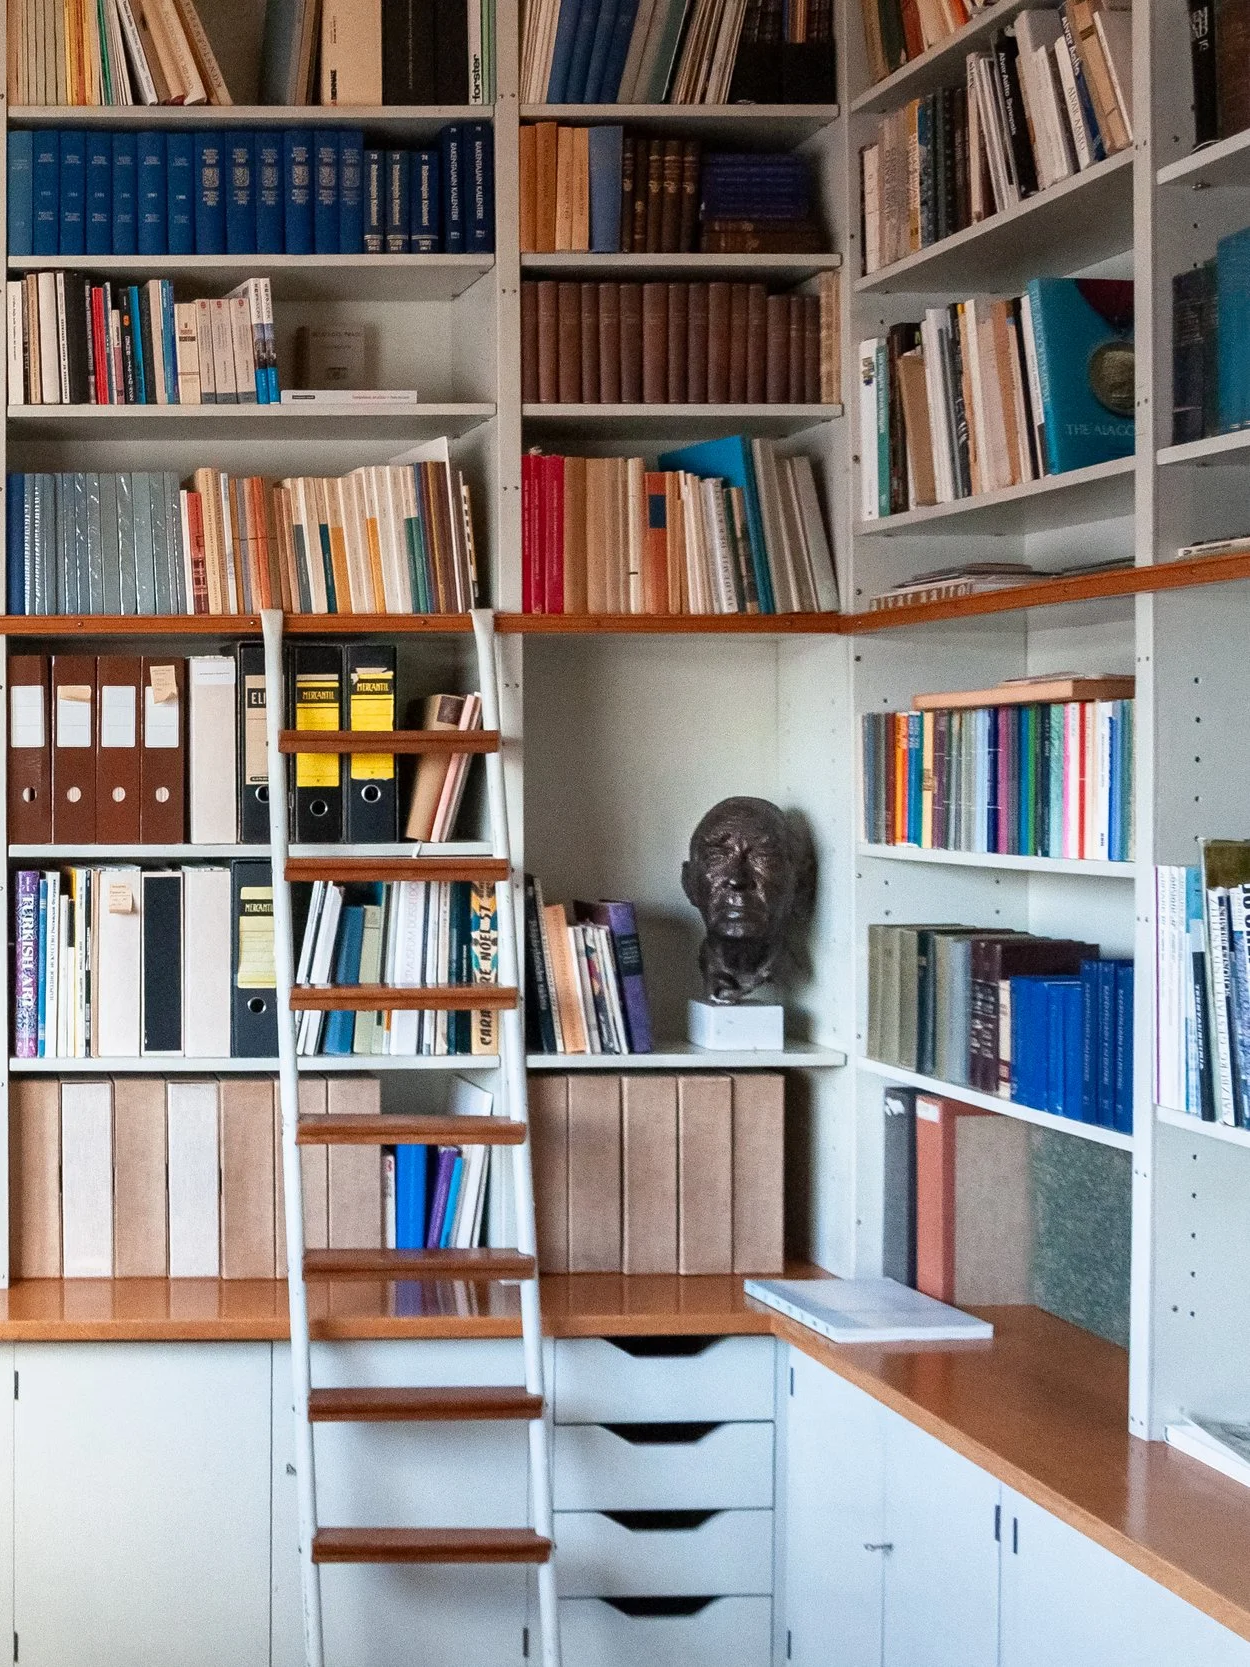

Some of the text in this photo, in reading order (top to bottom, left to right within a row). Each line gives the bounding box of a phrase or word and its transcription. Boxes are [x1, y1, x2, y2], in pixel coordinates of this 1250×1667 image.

[1060, 16, 1081, 76] Alvar Aalto
[471, 53, 481, 103] forster
[997, 52, 1017, 136] Alvar Aalto Synopsis
[449, 142, 459, 221] RAKENTAJAIN KALENTERI
[474, 141, 483, 185] RAKENTAJAIN
[1065, 423, 1091, 436] THE
[302, 691, 335, 700] MERCANTIL
[356, 682, 389, 692] MERCANTIL
[20, 893, 35, 1010] TURKISH ART
